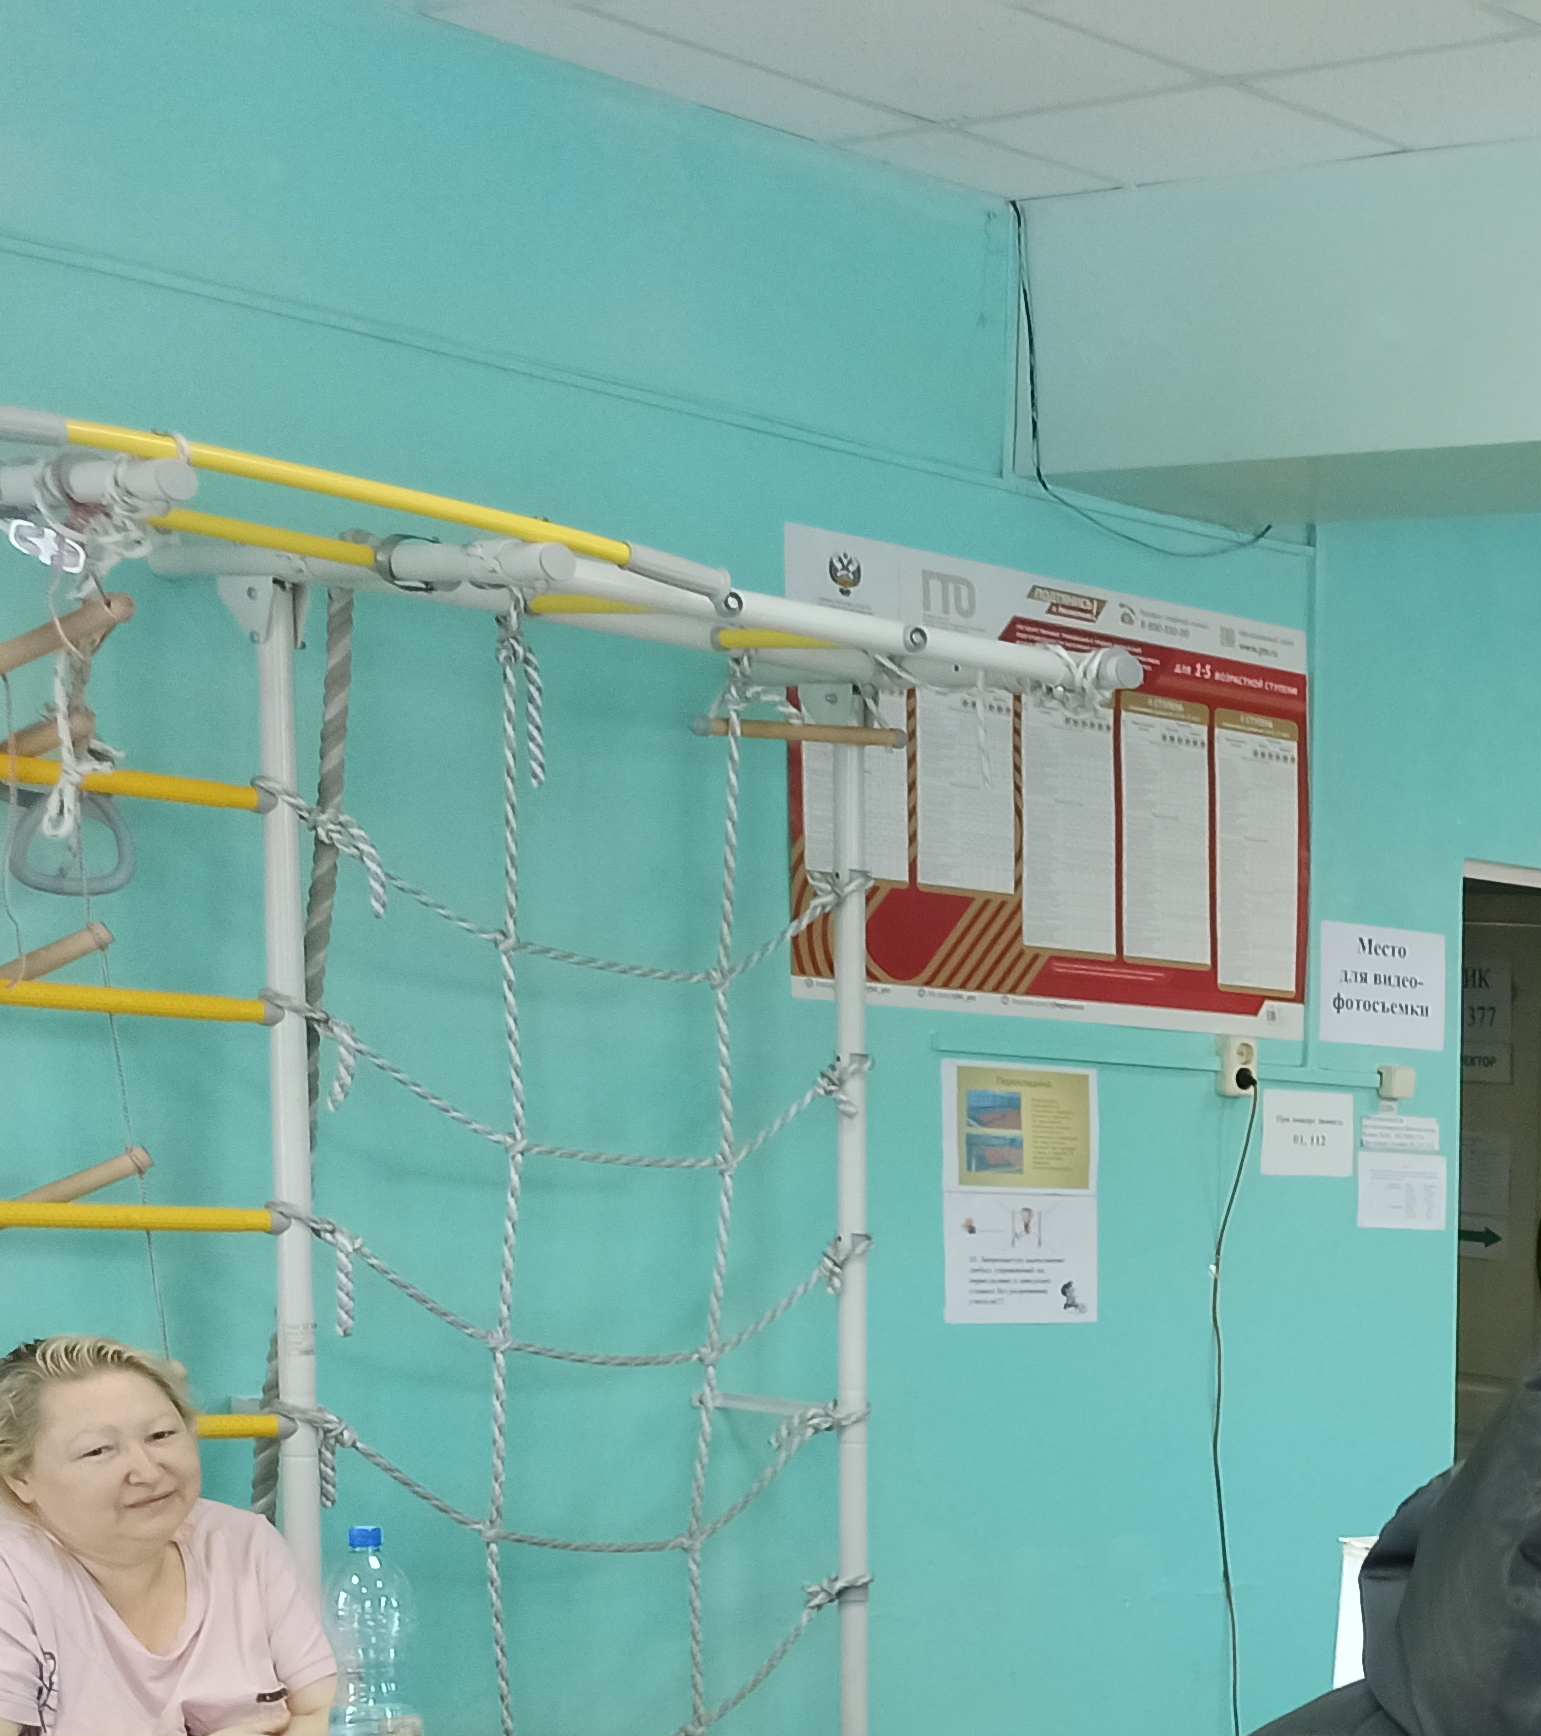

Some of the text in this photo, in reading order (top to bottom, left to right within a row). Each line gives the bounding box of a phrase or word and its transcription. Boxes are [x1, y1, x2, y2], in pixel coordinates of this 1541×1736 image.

[922, 569, 977, 619] ГТО
[1358, 936, 1408, 959] Место
[1340, 968, 1424, 989] для видео-
[1463, 967, 1490, 989] ИК
[1332, 991, 1430, 1018] фотосъемки
[1466, 1005, 1496, 1028] 377
[1463, 1054, 1498, 1068] ЕКТОР
